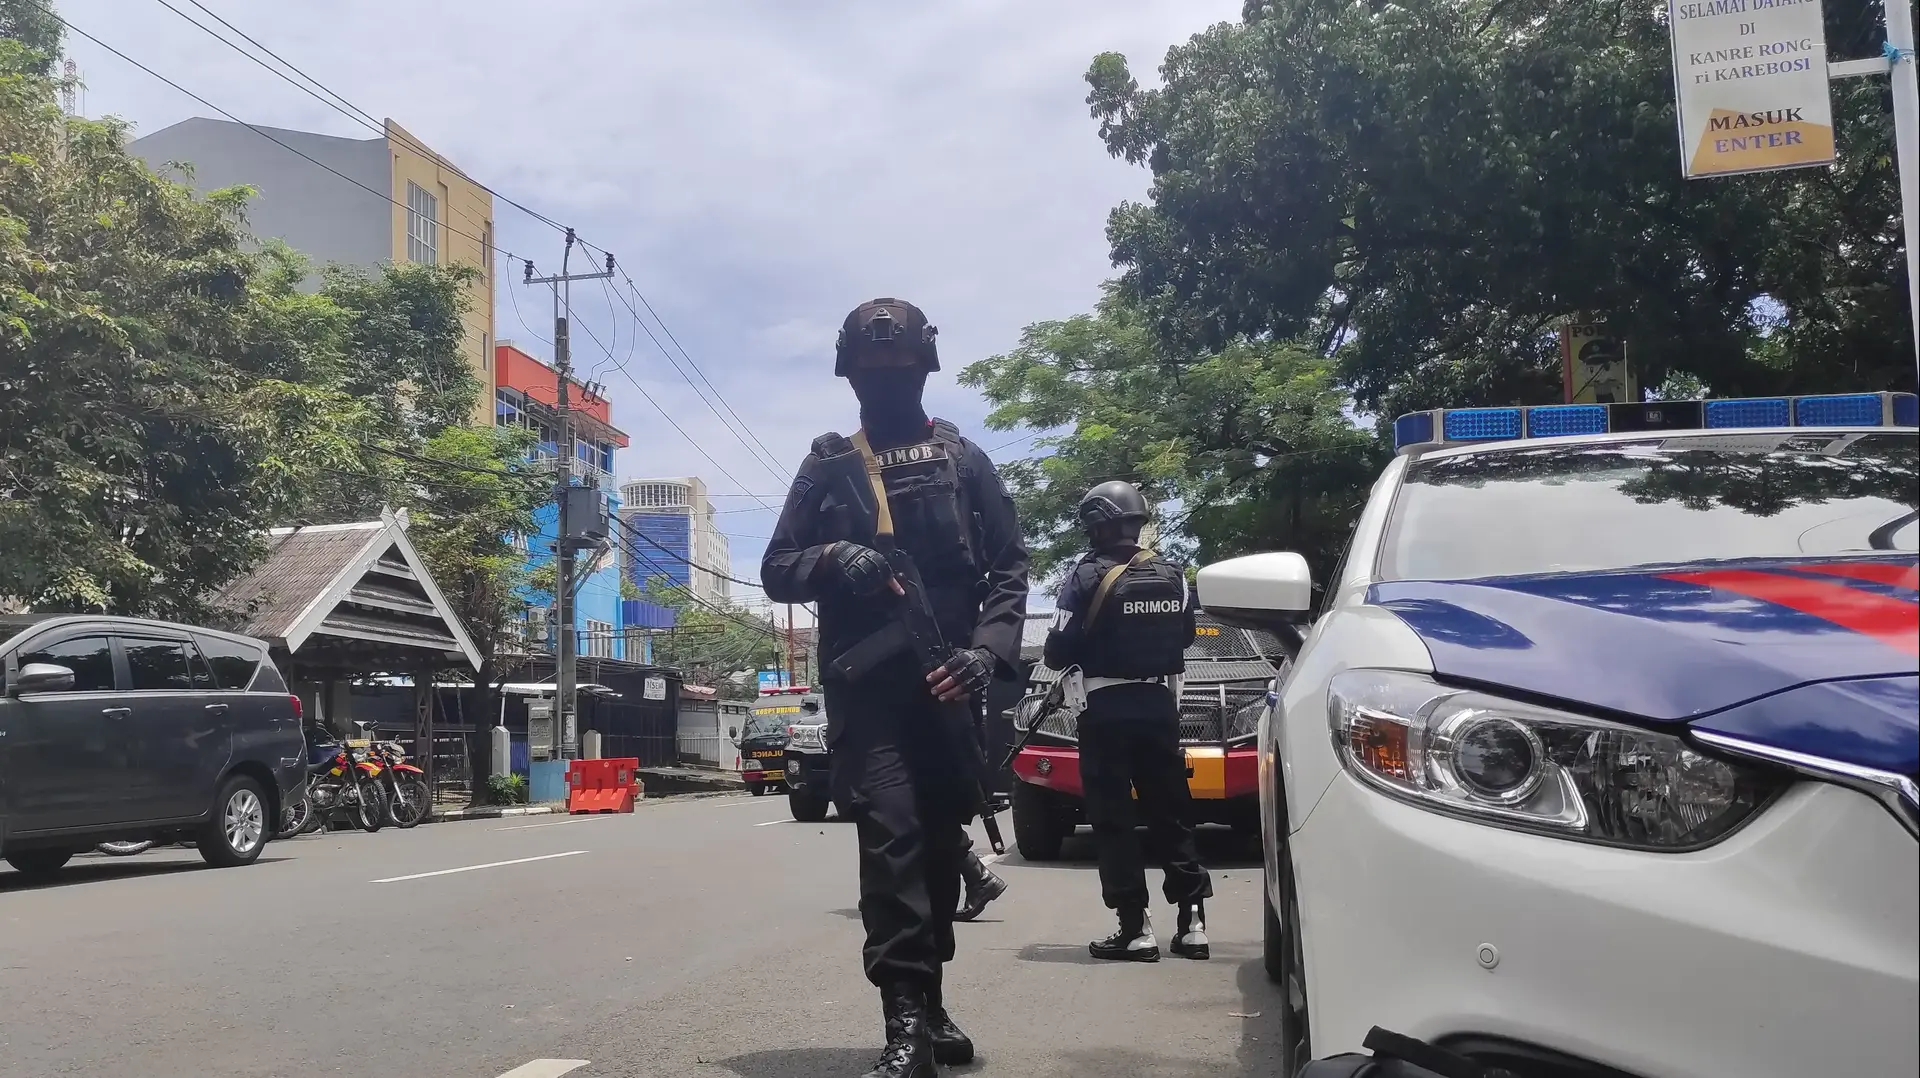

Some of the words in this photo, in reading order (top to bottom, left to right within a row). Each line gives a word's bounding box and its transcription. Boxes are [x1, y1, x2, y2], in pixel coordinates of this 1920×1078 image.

[1680, 0, 1747, 20] SELAMAT
[1753, 0, 1813, 10] DAT
[1740, 22, 1755, 35] DI
[1690, 46, 1753, 65] KANRE
[1759, 39, 1811, 56] RONG
[1695, 71, 1710, 84] ri
[1715, 58, 1810, 81] KAREBOSI
[1709, 107, 1804, 131] MASUK
[1715, 131, 1802, 153] ENTER
[875, 446, 933, 467] RIMOB
[1123, 600, 1180, 614] BRIMOB
